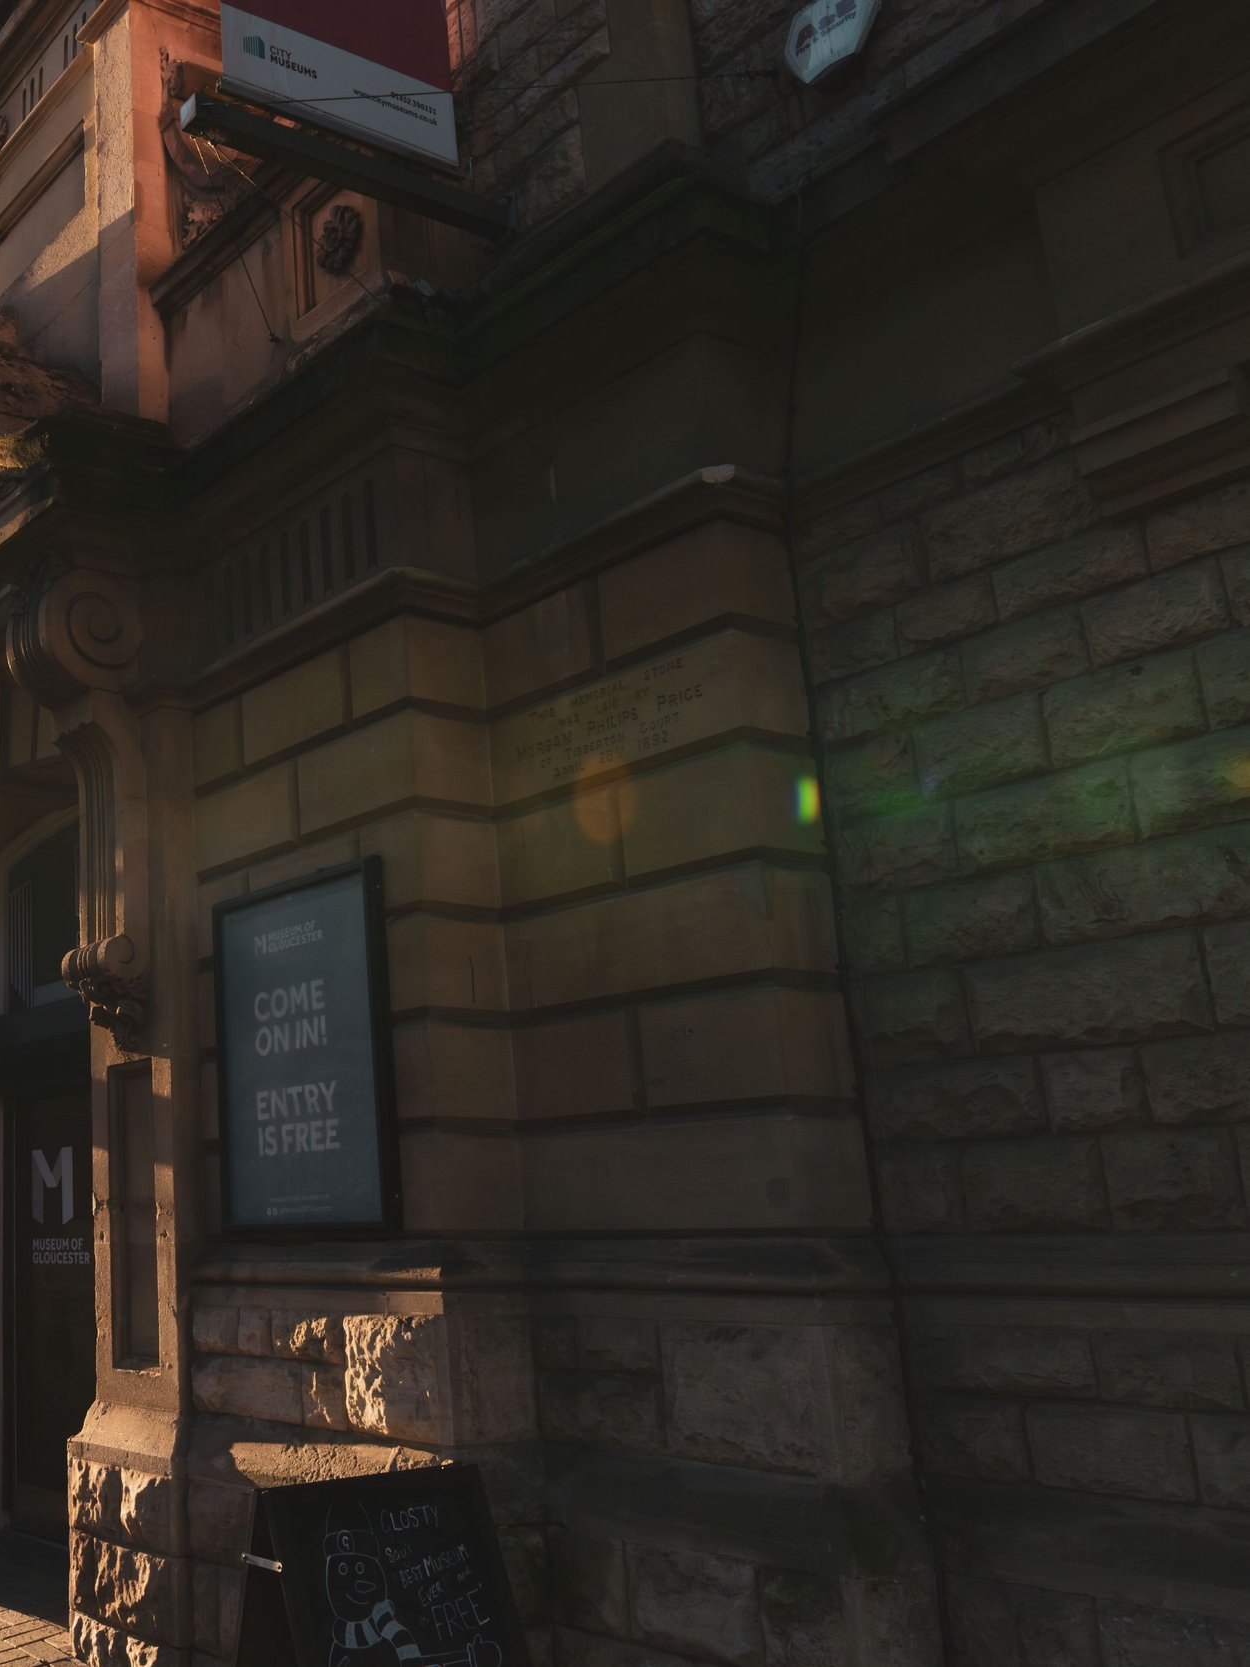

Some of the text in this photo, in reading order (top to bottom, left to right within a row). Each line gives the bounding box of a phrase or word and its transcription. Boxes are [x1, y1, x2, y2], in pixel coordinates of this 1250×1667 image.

[269, 44, 291, 60] CITY
[270, 54, 318, 79] MUSEUMS
[352, 88, 438, 126] www.citymuseums.co.uk
[413, 101, 437, 115] 396131
[570, 680, 627, 707] MEMORIAL
[644, 657, 684, 682] STONE
[595, 698, 620, 714] LAID
[515, 683, 703, 762] MORGAN PHILIPS PRICE
[639, 711, 680, 734] COURT
[553, 761, 585, 779] APRIL
[268, 919, 317, 942] MUSEUM OF
[268, 929, 324, 953] GLOUCESTER
[254, 978, 326, 1022] COME
[255, 1014, 328, 1057] ON IN!
[256, 1080, 337, 1121] ENTRY
[258, 1118, 341, 1157] IS FREE
[32, 1238, 83, 1250] MUSEUM OF
[32, 1252, 90, 1265] GLOUCESTER
